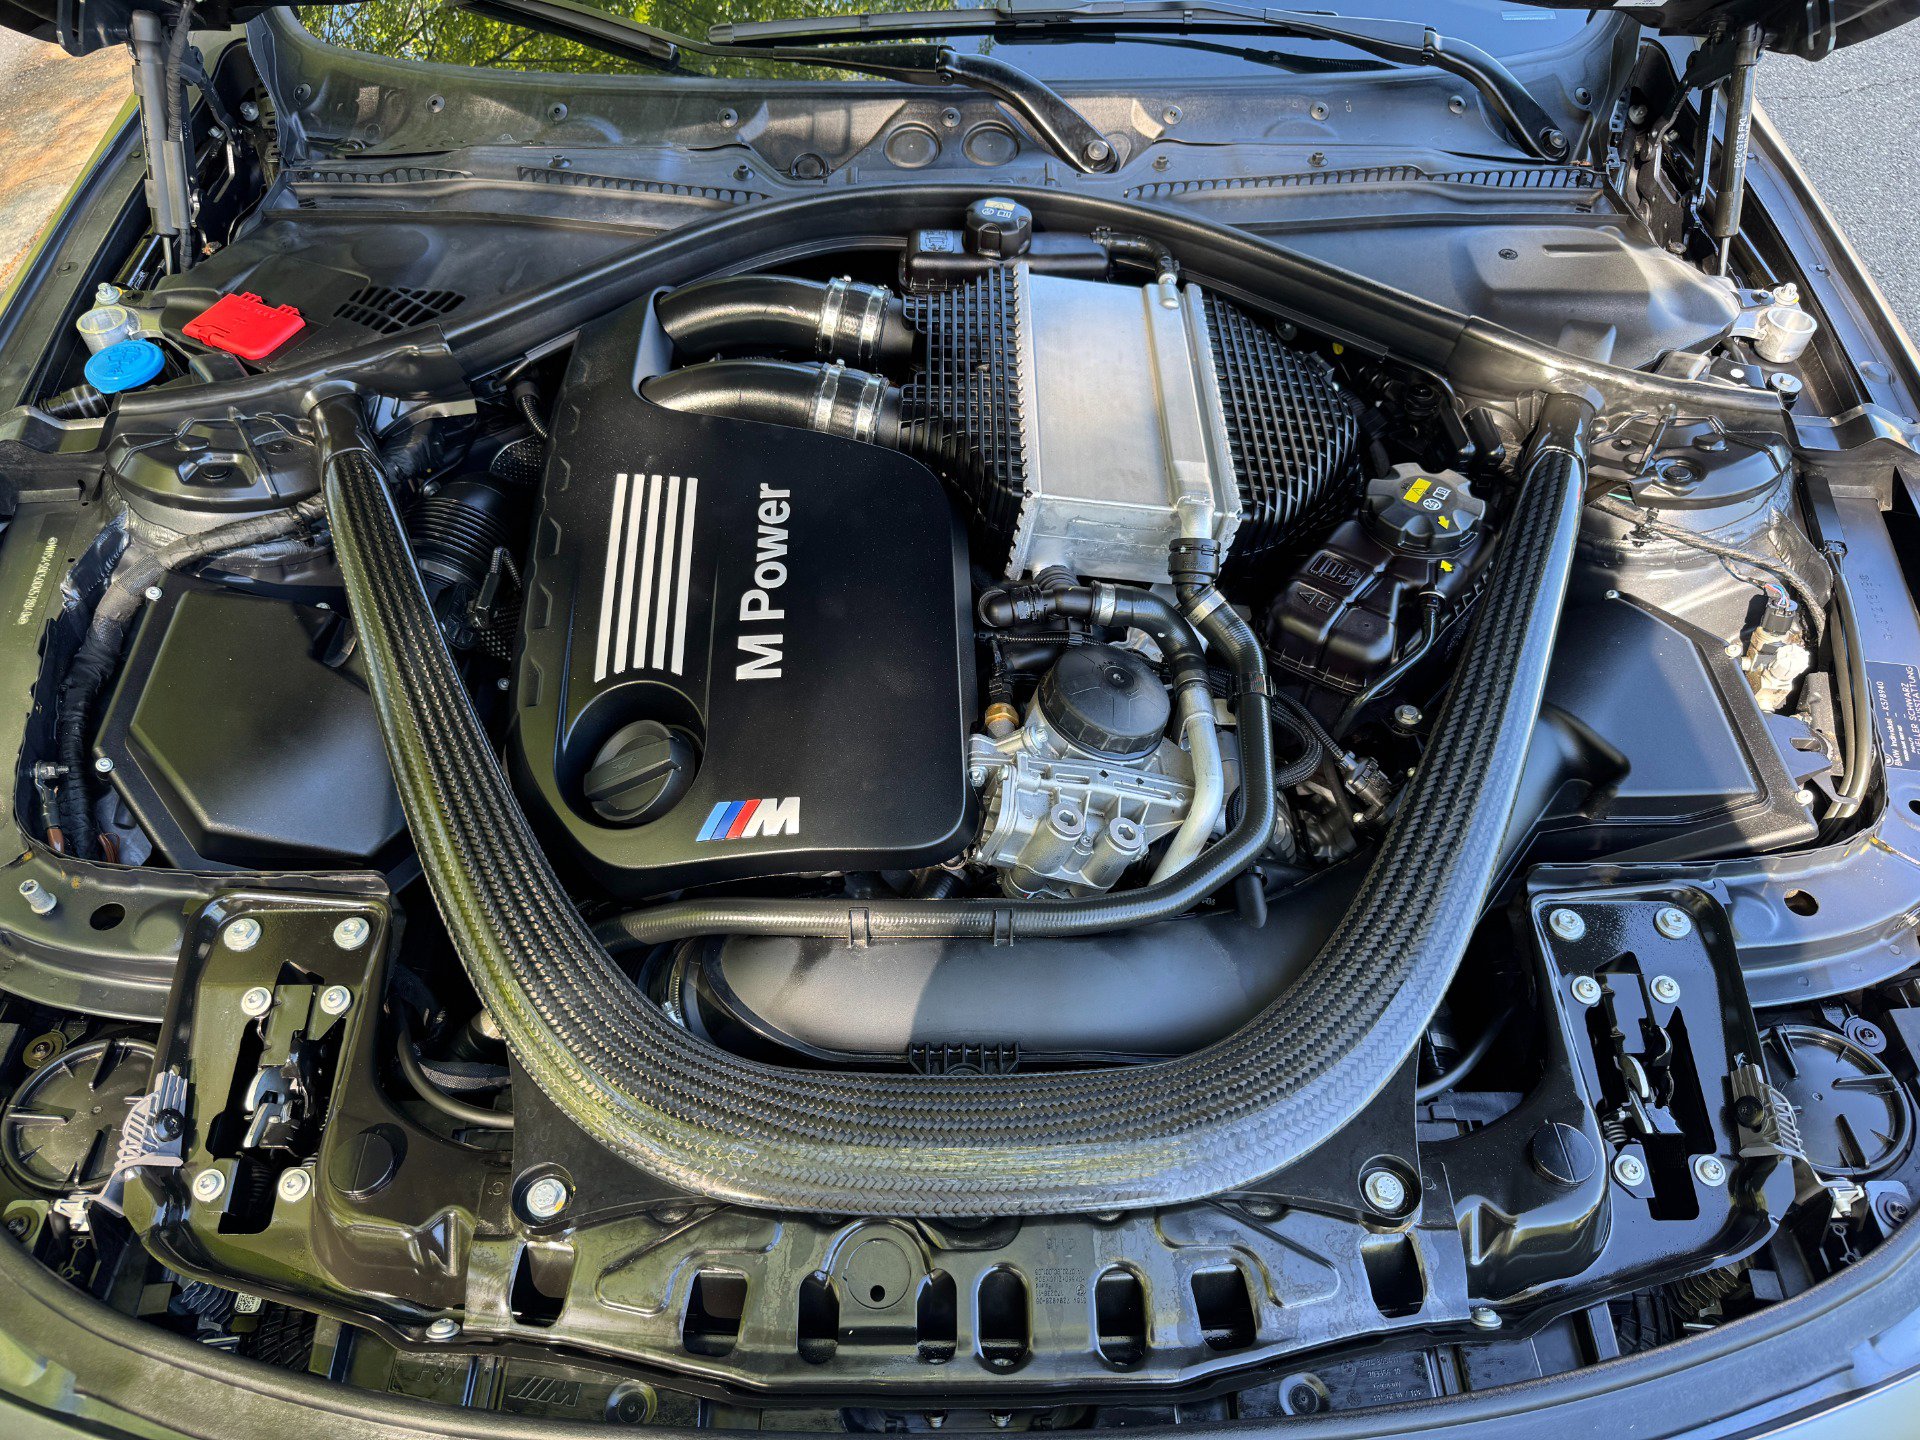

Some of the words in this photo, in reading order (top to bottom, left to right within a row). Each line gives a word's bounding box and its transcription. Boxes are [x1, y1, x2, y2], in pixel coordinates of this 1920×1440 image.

[1738, 115, 1748, 132] FKL
[1736, 133, 1745, 151] GTS
[1734, 152, 1743, 168] F82
[739, 482, 791, 622] Power
[736, 634, 784, 681] M
[1876, 681, 1890, 711] K578940
[1901, 682, 1917, 721] SCHWARZ
[1885, 717, 1898, 747] Individual
[1893, 749, 1903, 766] BMW
[740, 796, 801, 838] M
